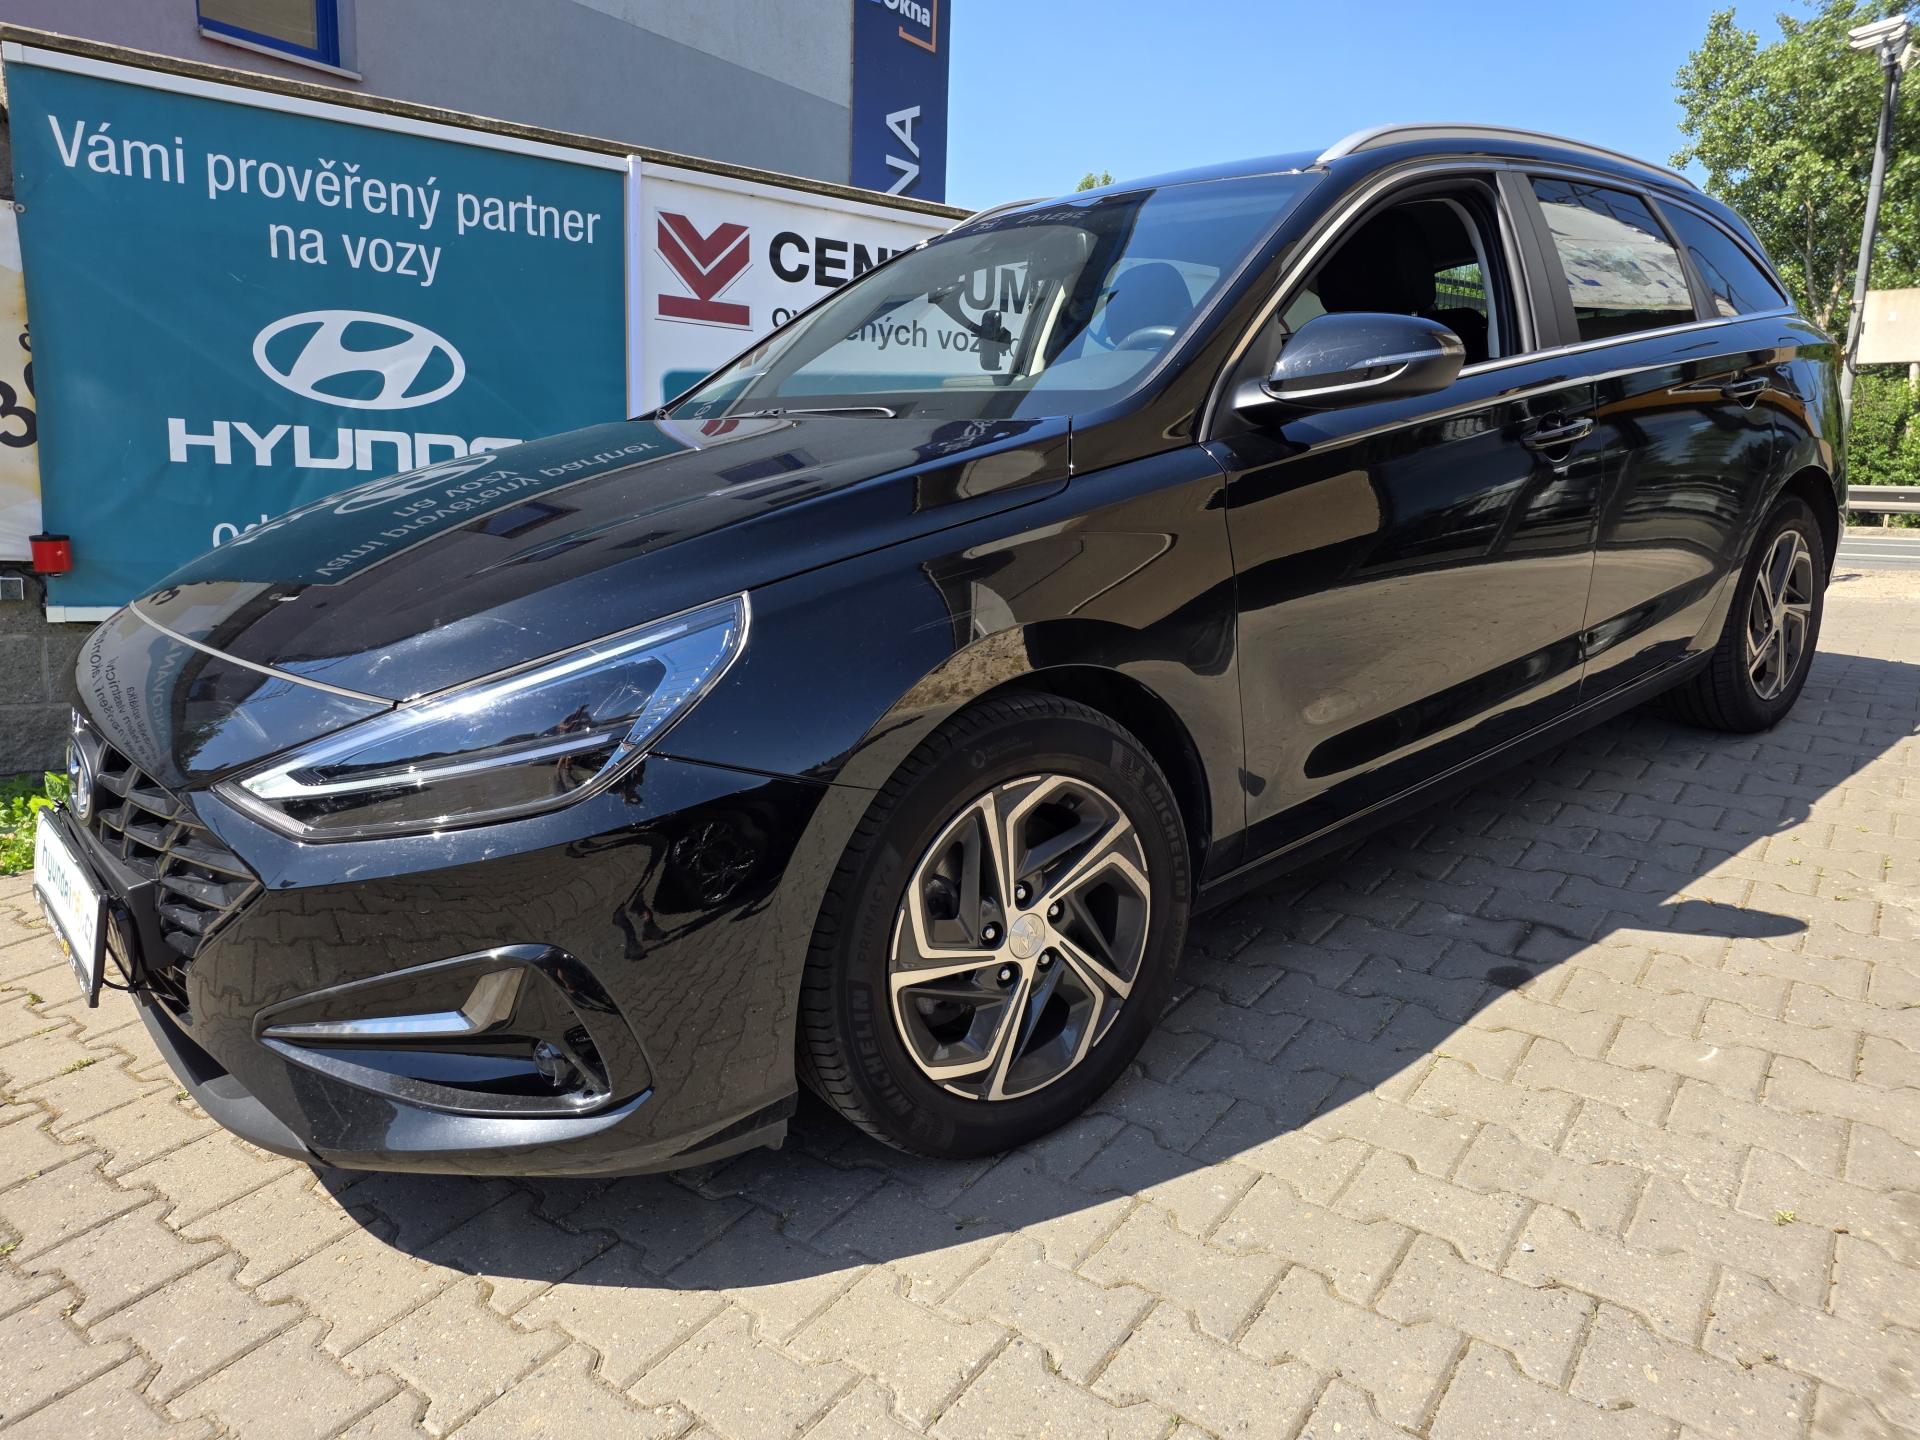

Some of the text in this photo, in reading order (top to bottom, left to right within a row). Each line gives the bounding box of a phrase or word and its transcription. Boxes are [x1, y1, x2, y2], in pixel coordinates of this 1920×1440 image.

[48, 115, 601, 244] Vámi prověřený partner
[269, 223, 441, 287] na vozy
[768, 231, 1031, 315] CENUM
[168, 417, 524, 472] HYUND
[1145, 783, 1187, 898] MICHELIN
